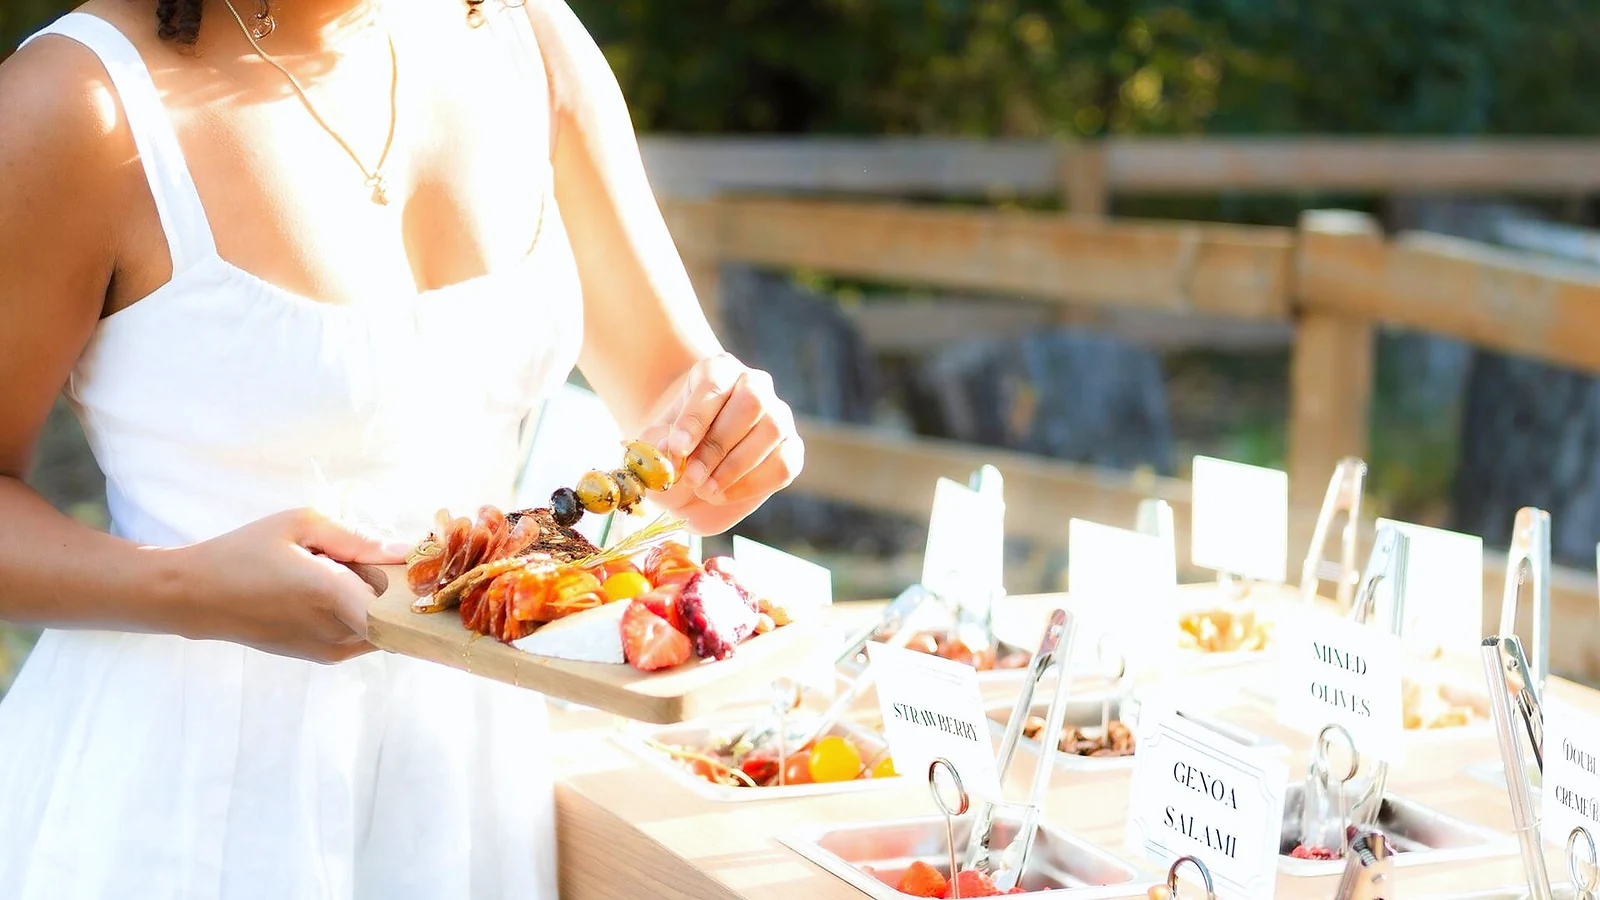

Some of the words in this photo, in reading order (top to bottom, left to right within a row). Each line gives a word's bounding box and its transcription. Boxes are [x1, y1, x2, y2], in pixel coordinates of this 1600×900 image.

[1313, 642, 1367, 675] MIXED
[1311, 682, 1371, 717] OLIVES
[893, 702, 978, 741] STRAWBERRY
[1562, 737, 1600, 777] DOUBL
[1173, 761, 1237, 810] GENOA
[1555, 784, 1589, 818] CREME
[1164, 805, 1237, 859] SALAMI
